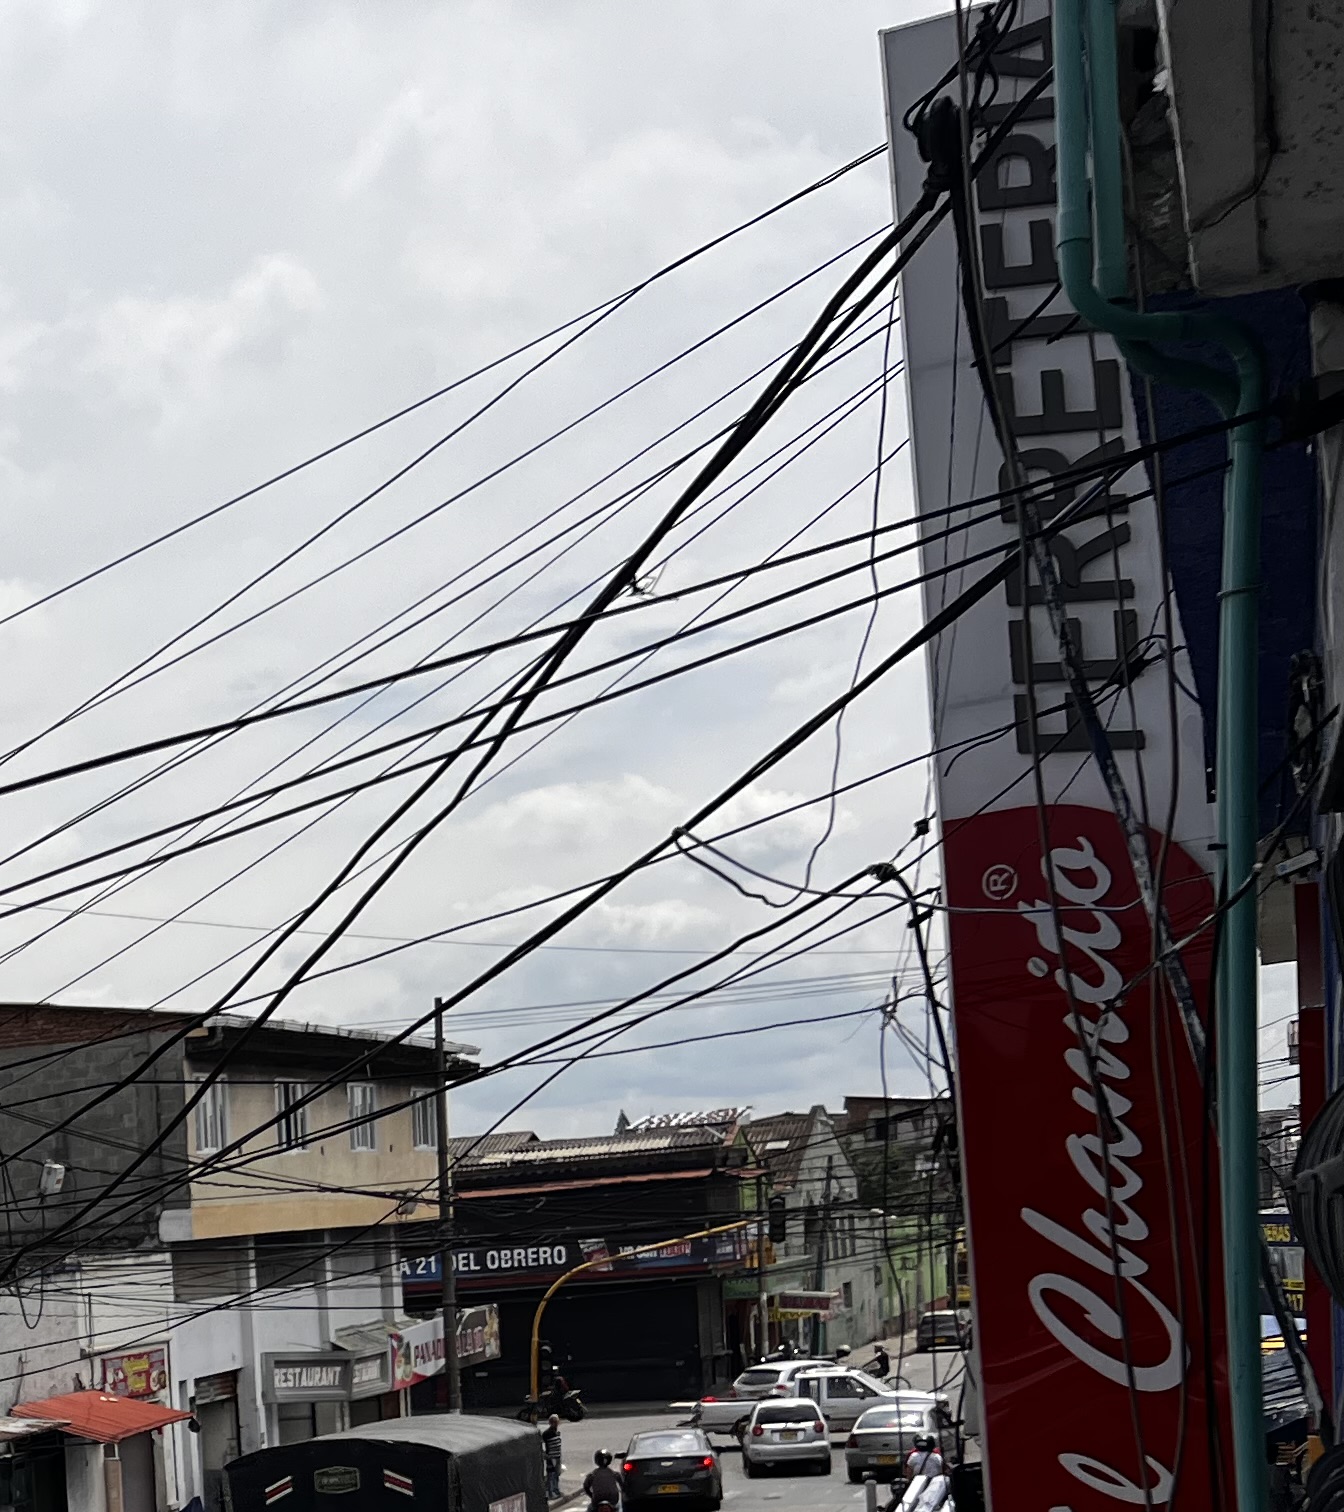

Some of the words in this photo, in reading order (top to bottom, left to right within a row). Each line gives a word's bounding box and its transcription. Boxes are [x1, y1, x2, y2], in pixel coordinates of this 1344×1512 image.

[1018, 836, 1191, 1392] Chamito
[416, 1256, 437, 1275] 21
[486, 1245, 567, 1270] OBRERO
[274, 1366, 342, 1388] RESTAURANT
